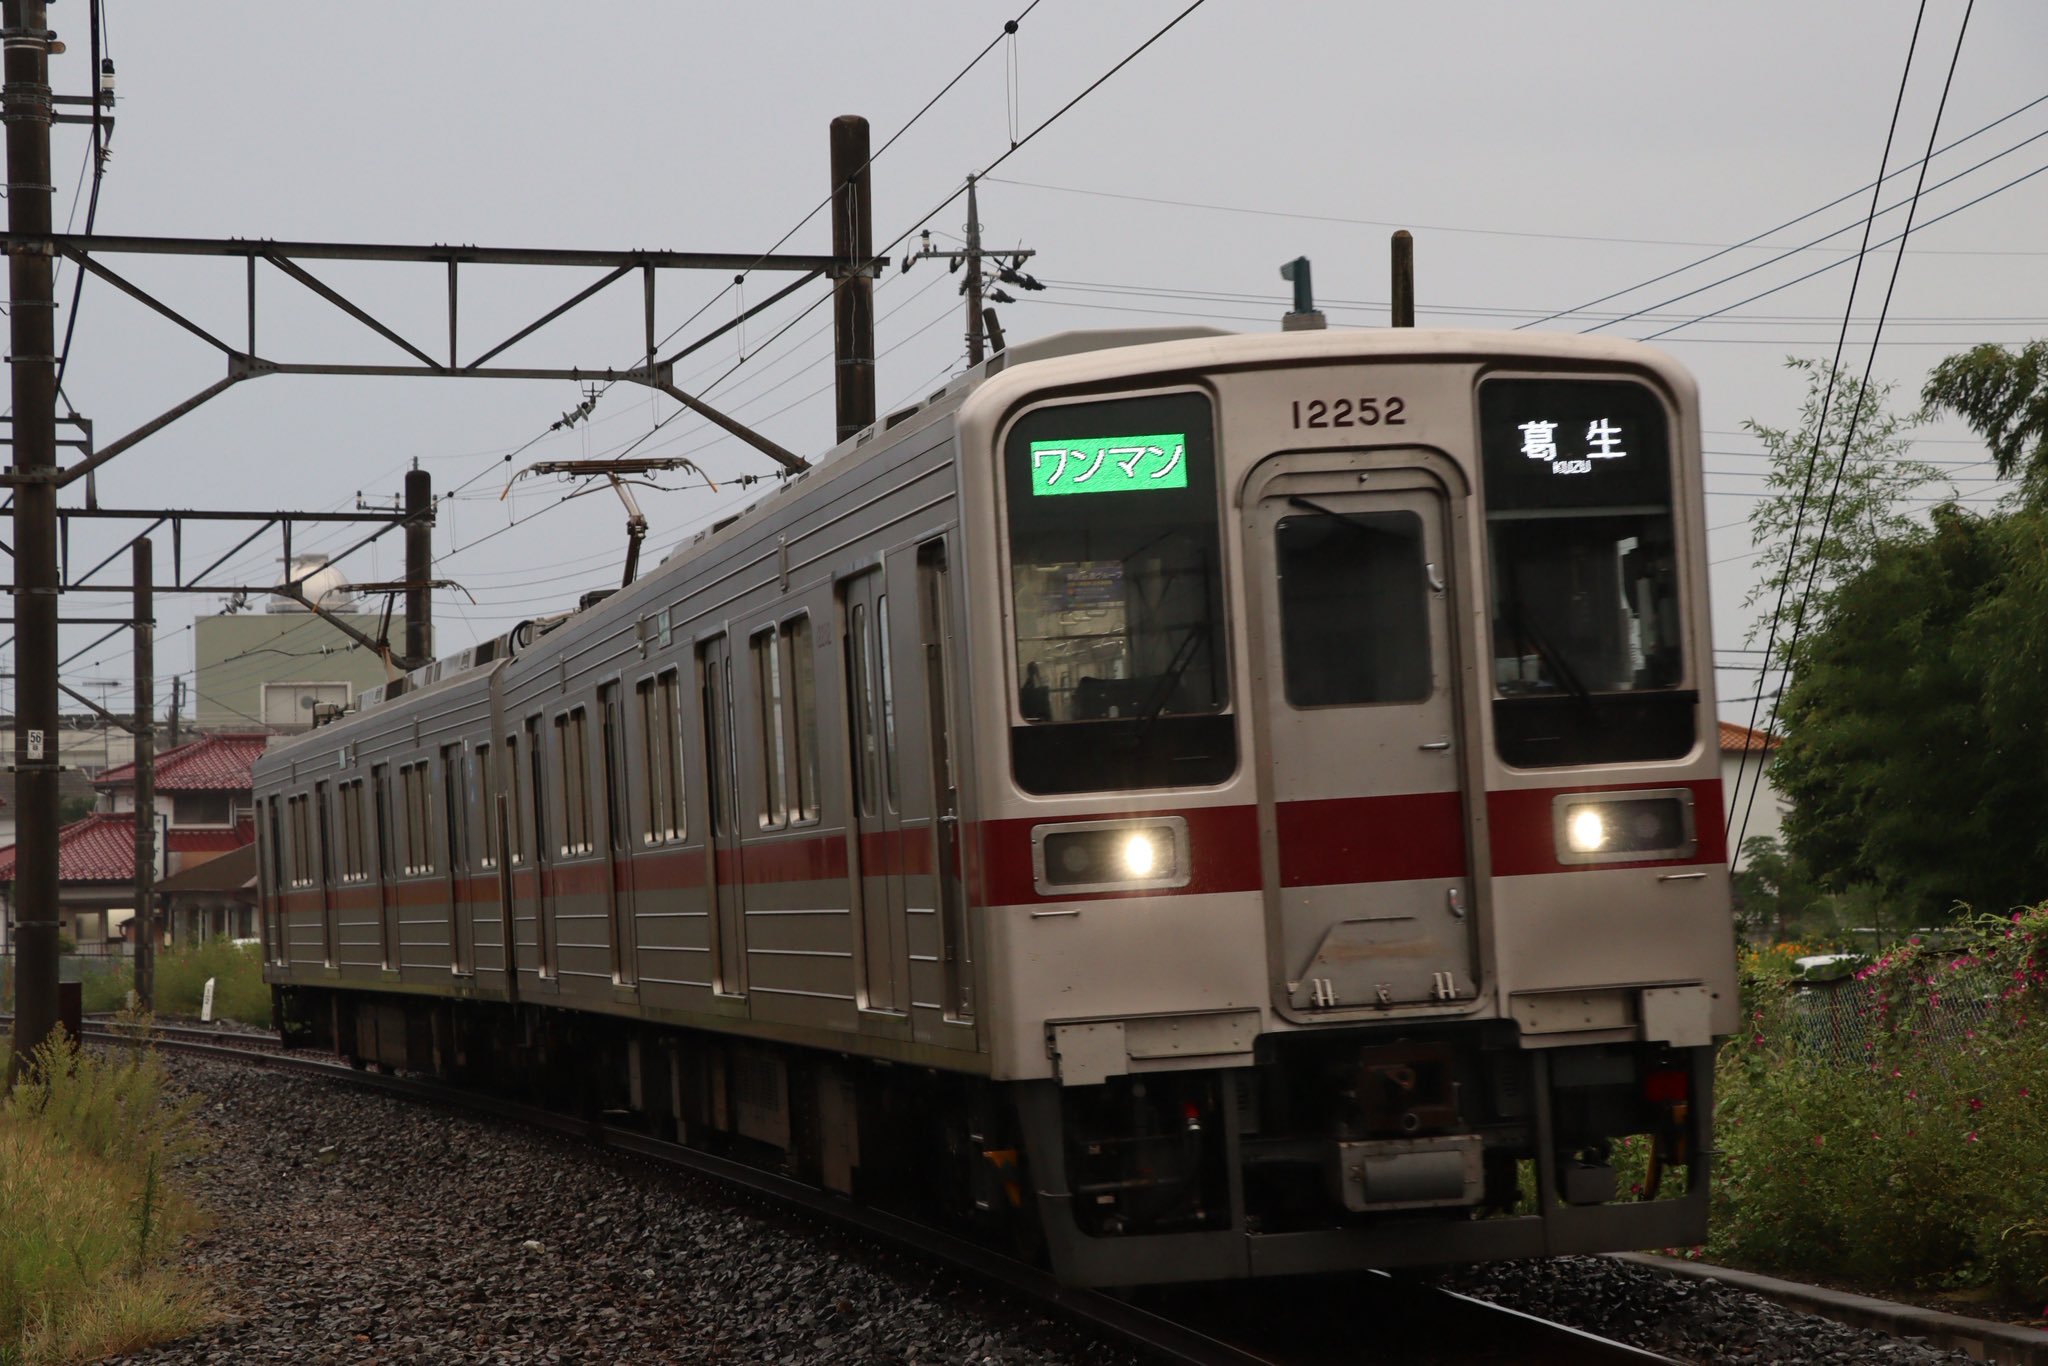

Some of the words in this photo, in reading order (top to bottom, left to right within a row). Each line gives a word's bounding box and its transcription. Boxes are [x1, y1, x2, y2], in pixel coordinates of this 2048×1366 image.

[1293, 398, 1406, 429] 12252
[1517, 418, 1627, 461] 葛生
[1033, 444, 1184, 486] ワンマン
[30, 731, 42, 744] 56
